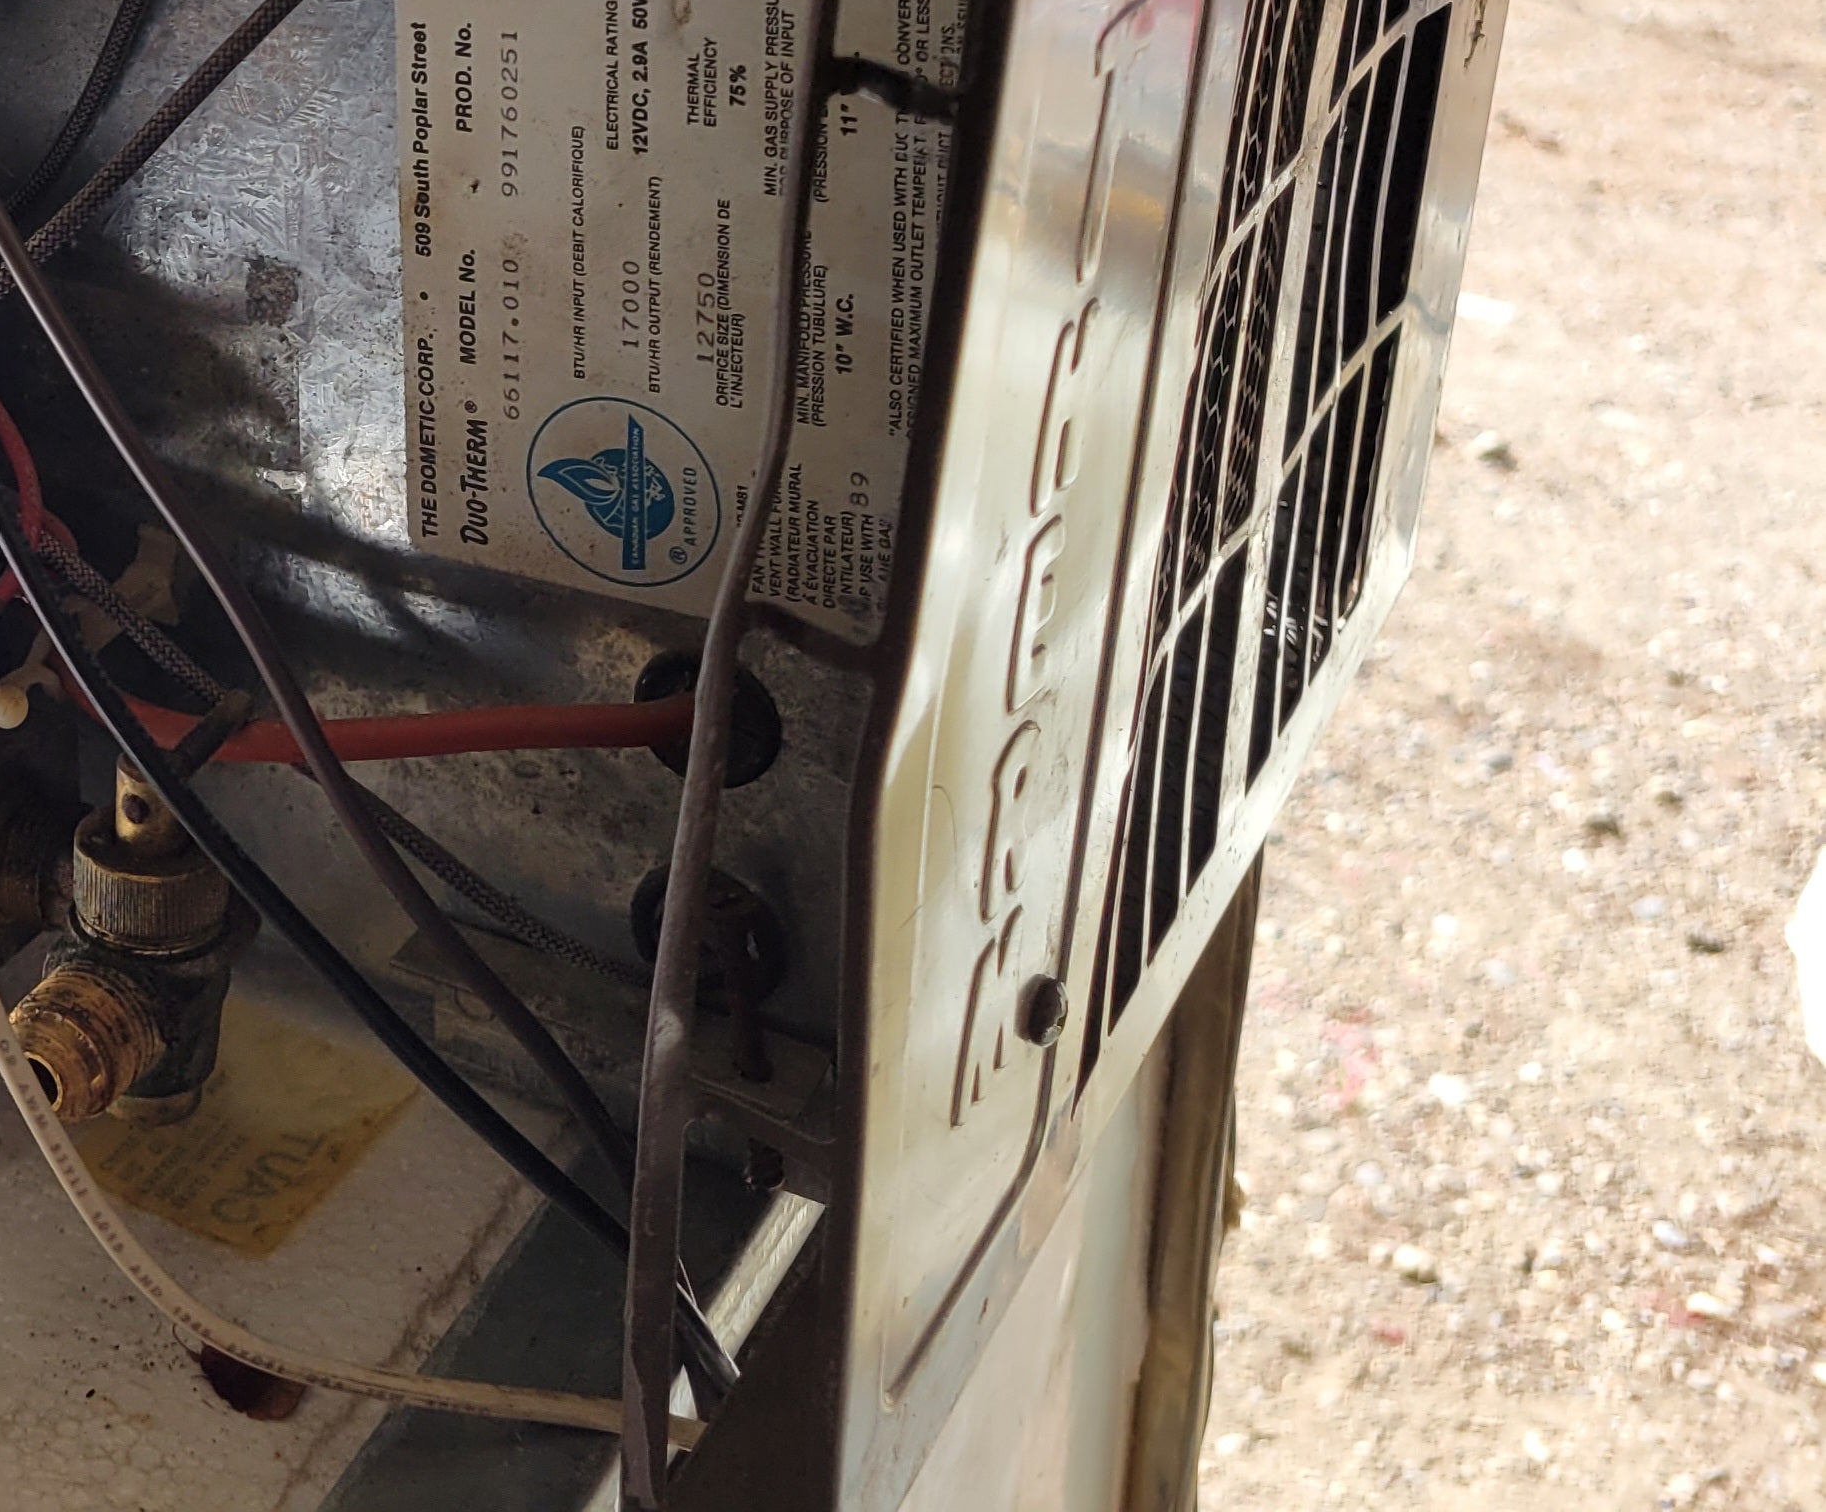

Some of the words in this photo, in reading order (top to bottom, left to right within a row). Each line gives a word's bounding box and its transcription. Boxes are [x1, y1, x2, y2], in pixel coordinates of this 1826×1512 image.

[410, 22, 428, 84] Street
[454, 22, 472, 58] No.
[606, 0, 618, 56] RATING
[781, 11, 795, 57] INPUT
[916, 39, 929, 61] OR
[632, 42, 648, 82] 2.9A
[686, 54, 700, 124] THERMAL
[704, 38, 718, 128] EFFICIENCY
[728, 64, 746, 106] 75%
[781, 61, 794, 83] OF
[456, 66, 472, 132] PROD.
[500, 32, 518, 196] 991760251
[606, 60, 620, 150] ELECTRICAL
[765, 61, 779, 121] SUPPLY
[412, 88, 432, 154] Poplar
[632, 88, 650, 154] 12VDC,
[764, 125, 778, 157] GAS
[412, 160, 430, 218] South
[572, 126, 586, 226] CALORIFIQUE)
[764, 163, 778, 196] MIN.
[895, 168, 909, 206] WITH
[648, 176, 662, 276] (RENDEMENT)
[718, 200, 730, 220] DE
[893, 212, 907, 252] USED
[414, 222, 432, 256] 509
[458, 250, 476, 282] No.
[572, 230, 586, 276] (DEBIT
[716, 223, 731, 311] (DIMENSION
[911, 224, 924, 281] OUTLET
[572, 278, 584, 322] INPUT
[622, 260, 640, 348] 17000
[813, 265, 829, 345] TUBULURE)
[892, 257, 906, 299] WHEN
[458, 290, 476, 364] MODEL
[648, 278, 660, 336] OUTPUT
[696, 272, 716, 362] 12750
[716, 314, 730, 346] SIZE
[837, 294, 853, 336] W.C.
[909, 286, 923, 359] MAXIMUM
[418, 334, 438, 398] CORP.
[502, 260, 520, 420] 66117.010
[574, 326, 586, 378] BTU/HR
[648, 340, 660, 394] BTU/HR
[730, 313, 746, 408] L'INJECTEUR)
[797, 312, 811, 388] MANIFOLD
[890, 308, 904, 385] CERTIFIED
[716, 349, 730, 406] ORIFICE
[812, 351, 826, 427] (PRESSION
[797, 393, 810, 424] MIN.
[418, 394, 438, 494] DOMETIC
[630, 428, 640, 490] ASSOCIATION
[631, 494, 639, 512] GAS
[683, 467, 697, 546] APPROVED
[788, 463, 802, 512] MURAL
[420, 498, 438, 538] THE
[770, 517, 782, 556] WALL
[824, 515, 836, 544] PAR
[861, 514, 873, 550] WITH
[769, 560, 782, 597] VENT
[786, 516, 801, 602] (RADIATEUR
[824, 550, 836, 609] DIRECTE
